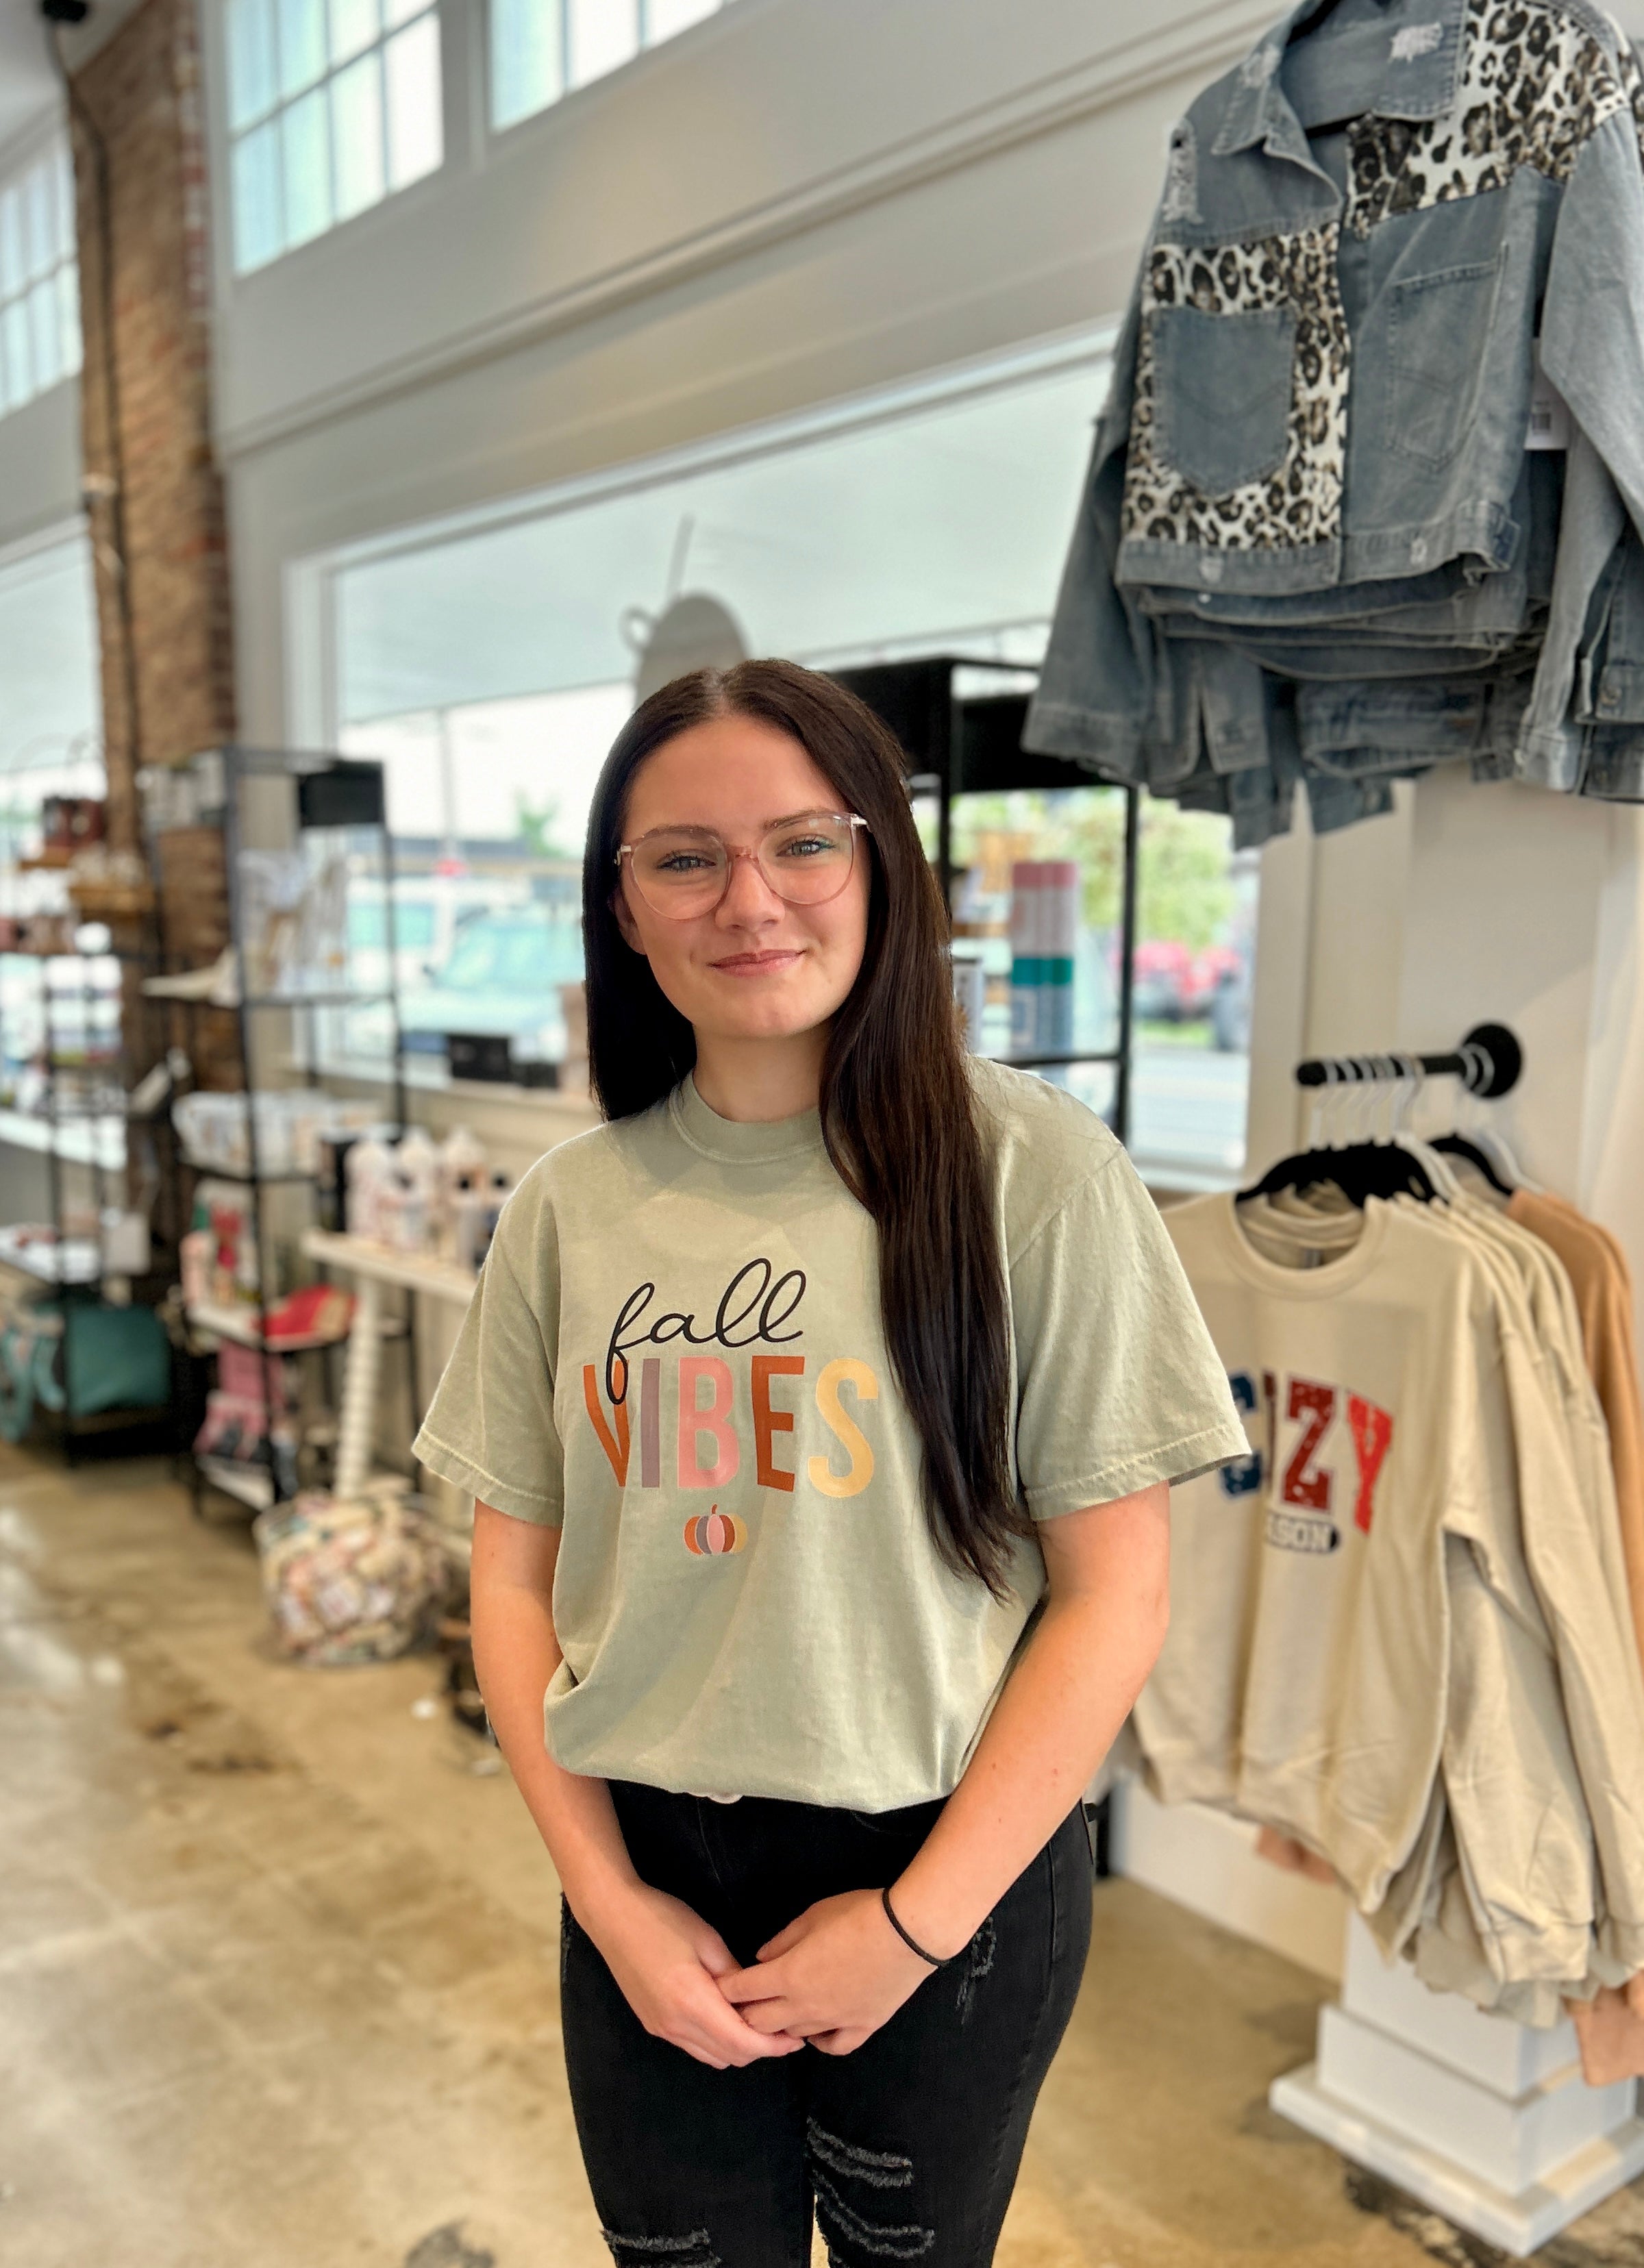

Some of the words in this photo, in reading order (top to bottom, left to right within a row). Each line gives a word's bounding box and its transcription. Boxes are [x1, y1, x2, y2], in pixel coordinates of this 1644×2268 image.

[606, 1258, 807, 1405] fall
[583, 1355, 879, 1499] VIBES
[1217, 1367, 1394, 1536] CZY
